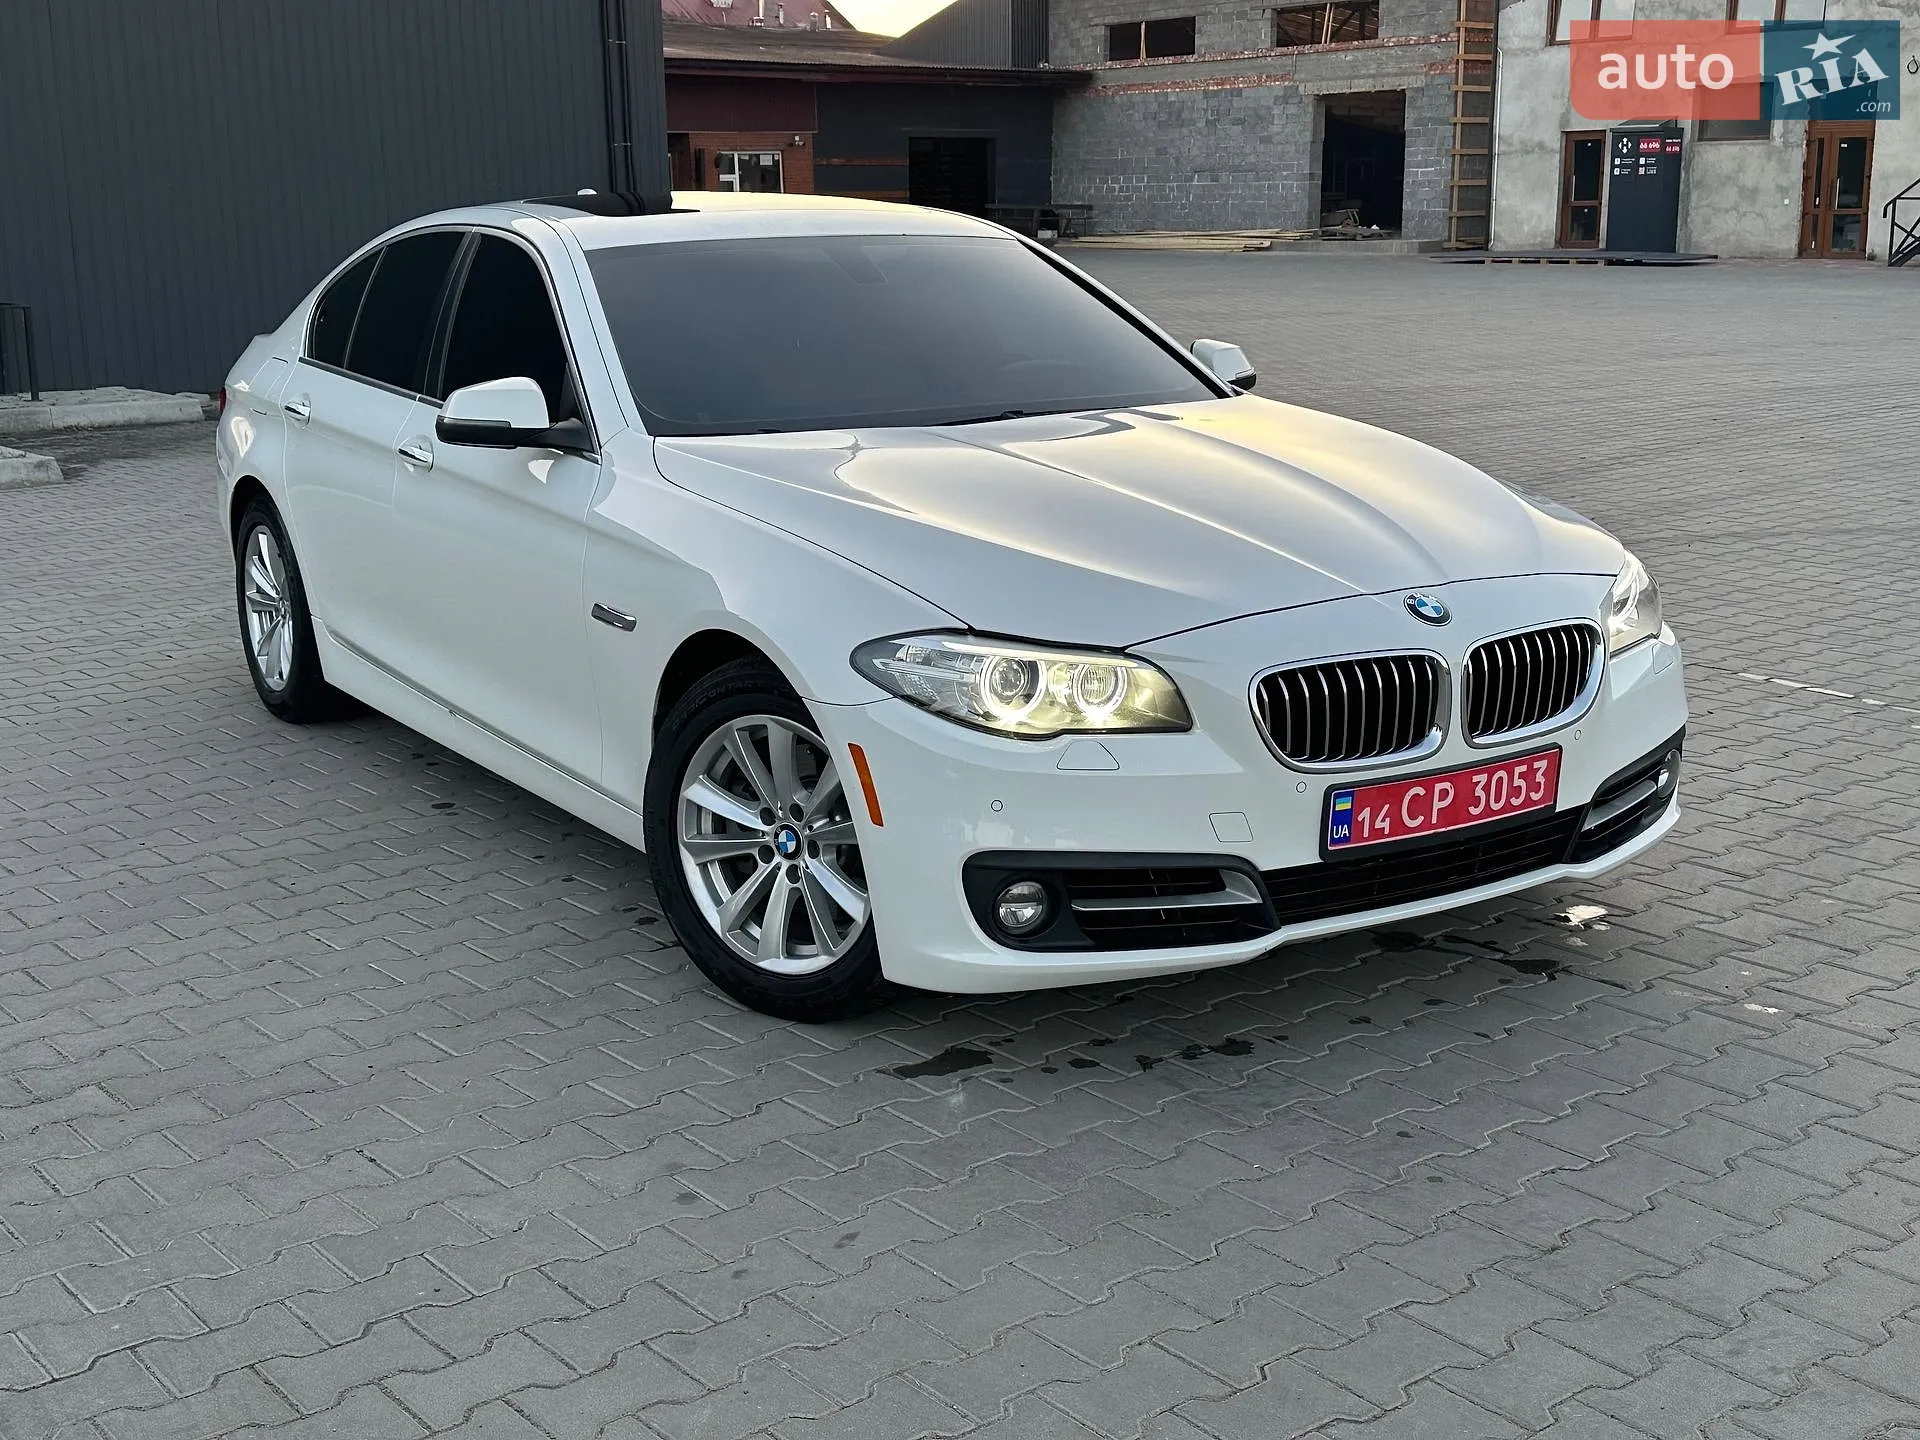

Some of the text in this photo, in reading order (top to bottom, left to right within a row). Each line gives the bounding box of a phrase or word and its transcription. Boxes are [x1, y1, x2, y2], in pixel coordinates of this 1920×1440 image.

[1357, 759, 1548, 838] 14 CP 3053
[1333, 824, 1350, 839] UA
